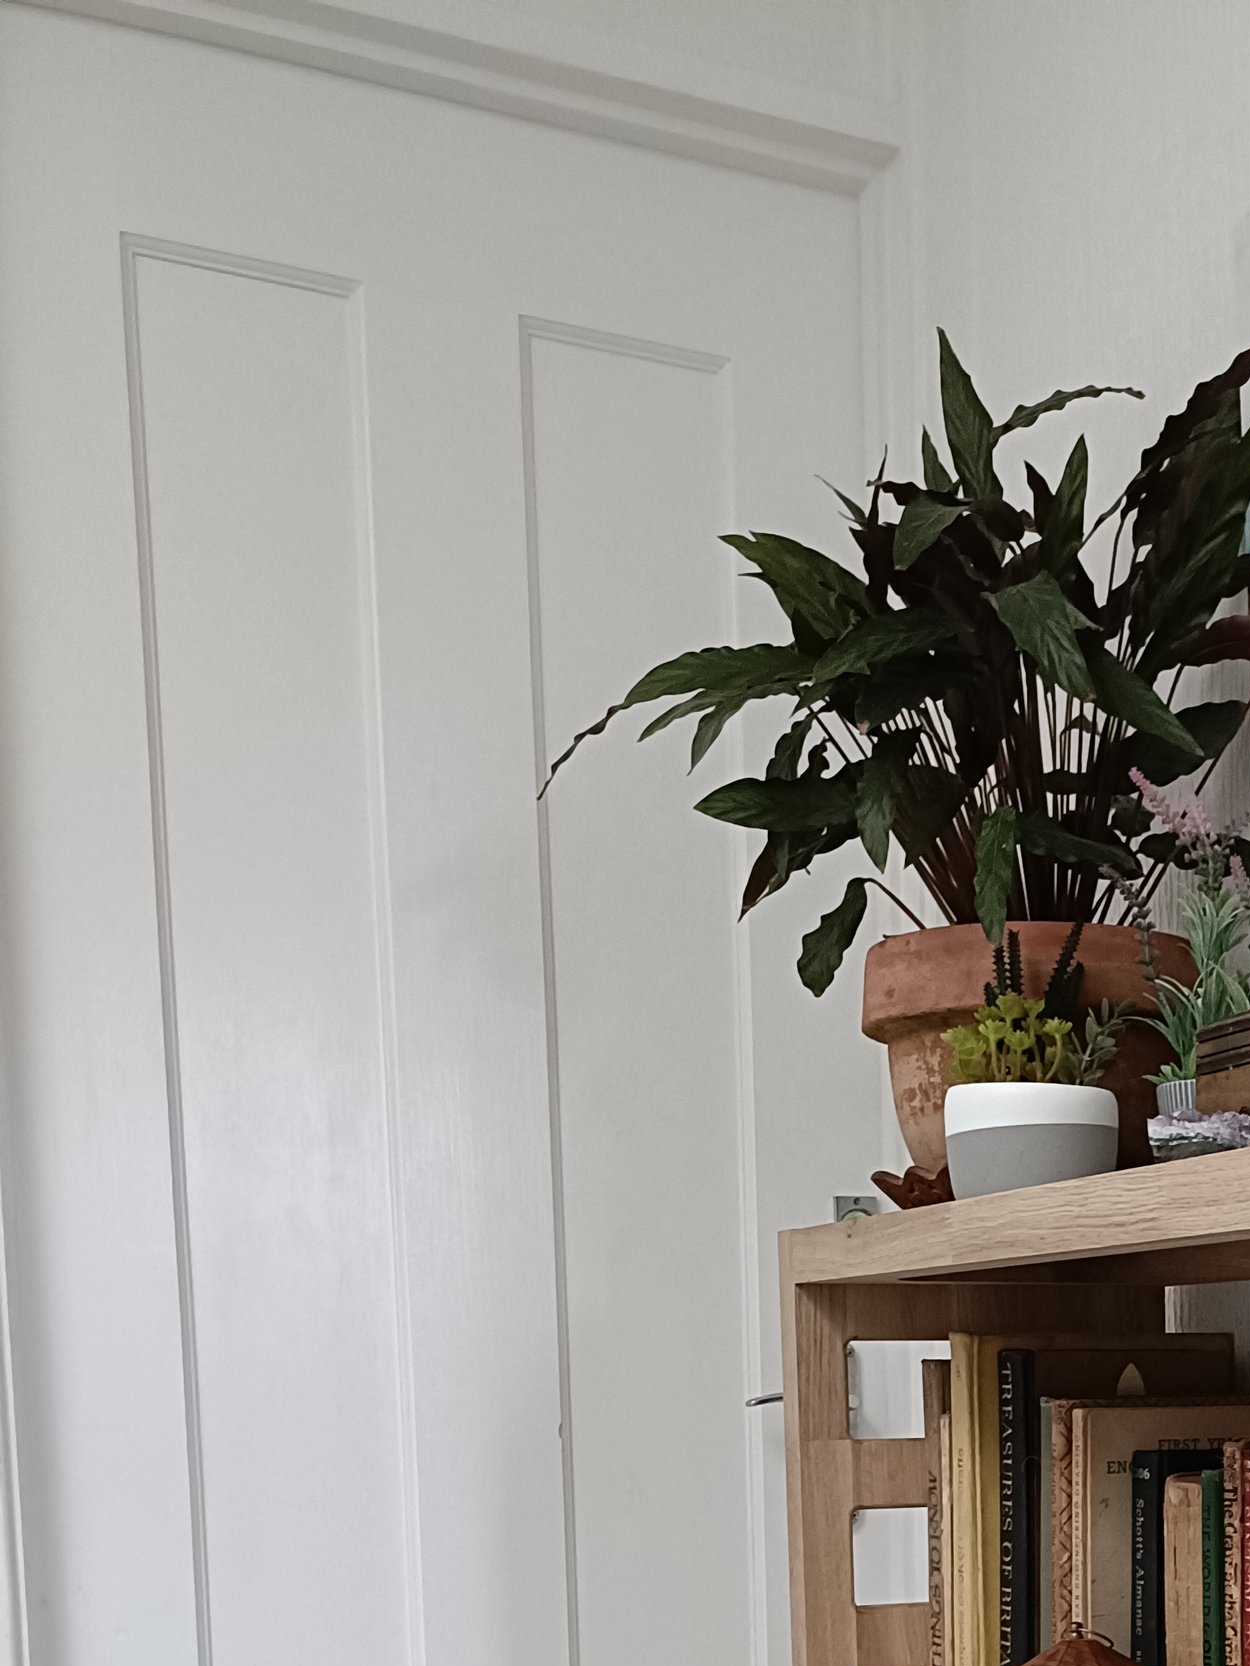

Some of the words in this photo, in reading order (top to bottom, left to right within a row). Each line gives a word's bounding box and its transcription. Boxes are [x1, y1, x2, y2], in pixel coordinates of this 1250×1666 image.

[1001, 1362, 1013, 1531] TREASURES
[1157, 1437, 1200, 1450] FIRST
[927, 1470, 943, 1539] KNOW
[1202, 1504, 1211, 1542] THE
[1224, 1486, 1239, 1519] The
[1135, 1498, 1145, 1560] Schott's
[929, 1545, 942, 1576] TO
[1001, 1541, 1013, 1580] OF
[1202, 1548, 1211, 1617] WORLD
[1135, 1564, 1145, 1636] Almanac
